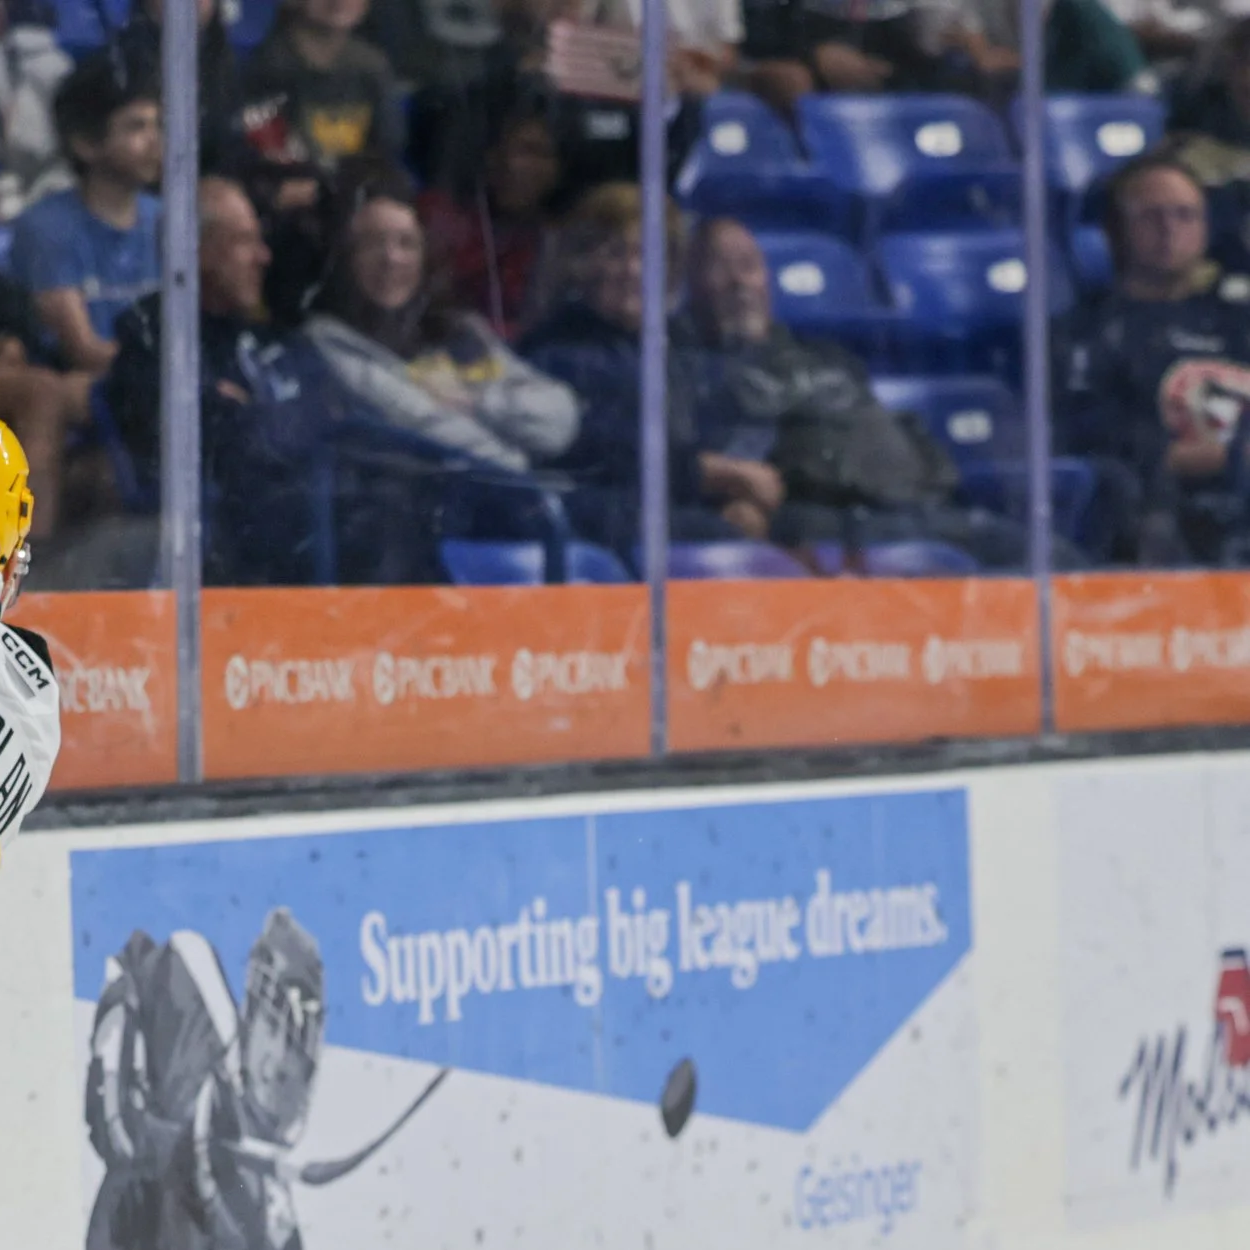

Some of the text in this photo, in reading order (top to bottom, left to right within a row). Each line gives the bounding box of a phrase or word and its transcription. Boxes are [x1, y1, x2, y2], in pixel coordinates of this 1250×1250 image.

[1, 631, 50, 691] CCM
[360, 867, 950, 1025] Supporting big league dreams.
